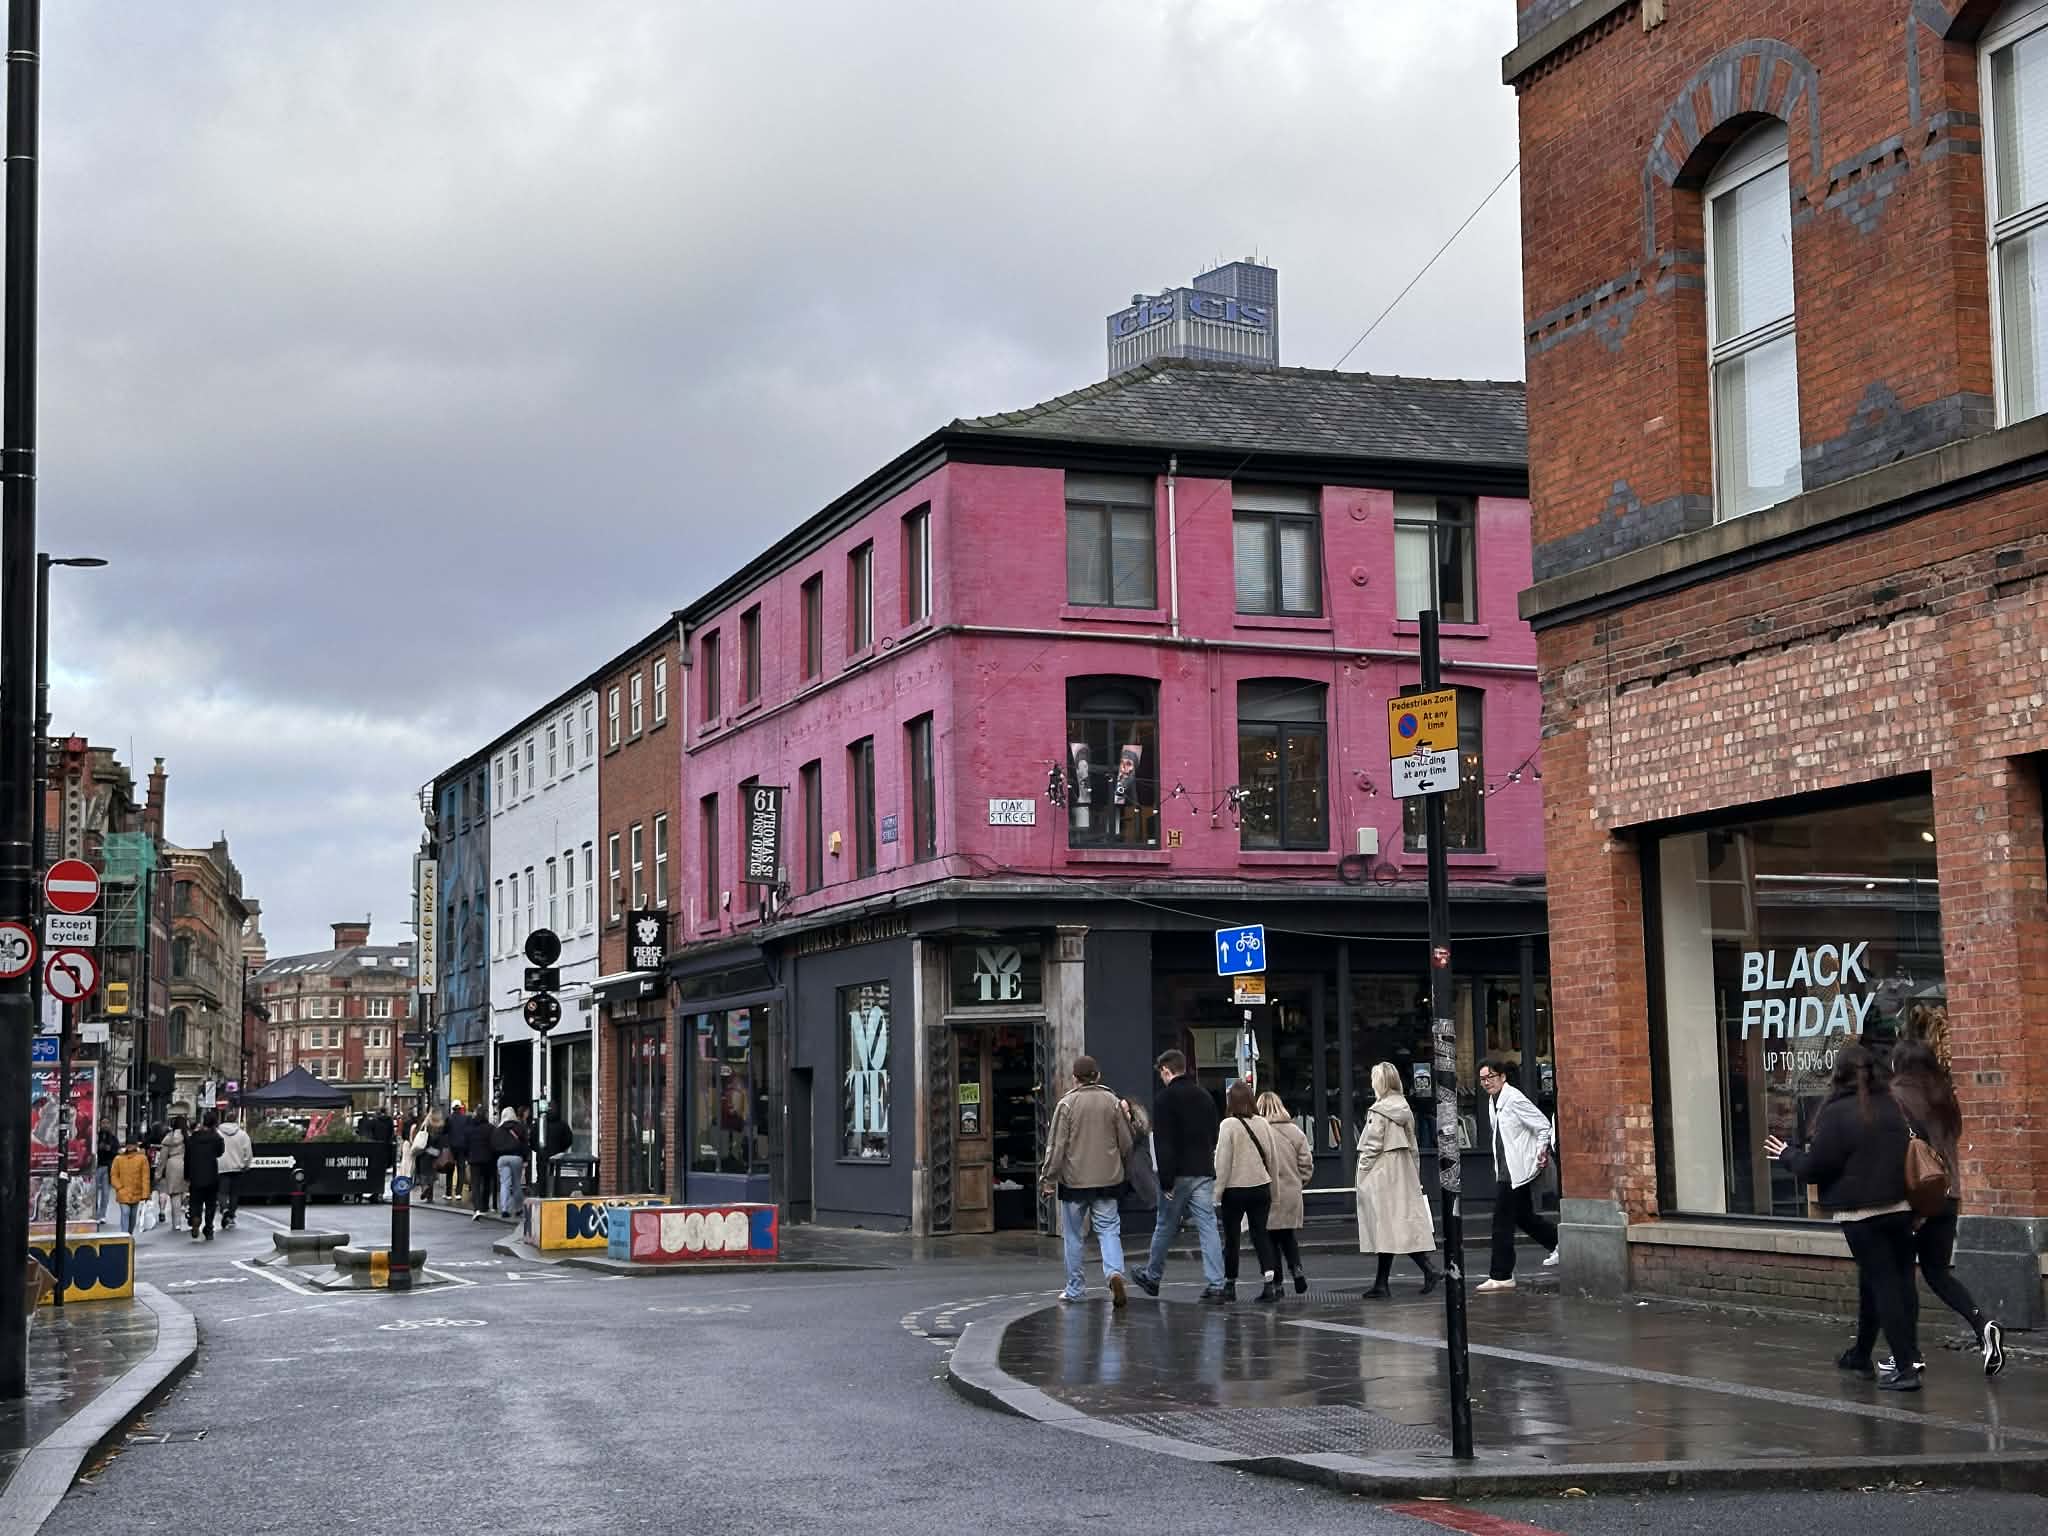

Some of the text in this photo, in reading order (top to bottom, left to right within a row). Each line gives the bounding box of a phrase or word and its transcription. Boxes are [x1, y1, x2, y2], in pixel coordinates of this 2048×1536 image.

[1391, 694, 1454, 711] Pedestrian Zone
[1423, 710, 1448, 721] At any
[1427, 720, 1445, 729] time
[1404, 756, 1446, 769] No ding
[1403, 766, 1447, 779] at any time
[754, 789, 776, 812] 61
[1001, 801, 1024, 812] OAK
[990, 812, 1035, 823] STREET
[750, 811, 764, 876] POST OFFICE
[762, 812, 776, 863] THOMAS
[51, 919, 92, 931] Except
[52, 931, 89, 942] cycles
[633, 946, 663, 957] FIERCE
[636, 956, 659, 967] BEER
[1742, 941, 1870, 992] BLACK
[1741, 991, 1876, 1040] FRIDAY
[1763, 1051, 1778, 1071] UP
[1780, 1050, 1795, 1071] TO
[1797, 1050, 1823, 1070] 50%
